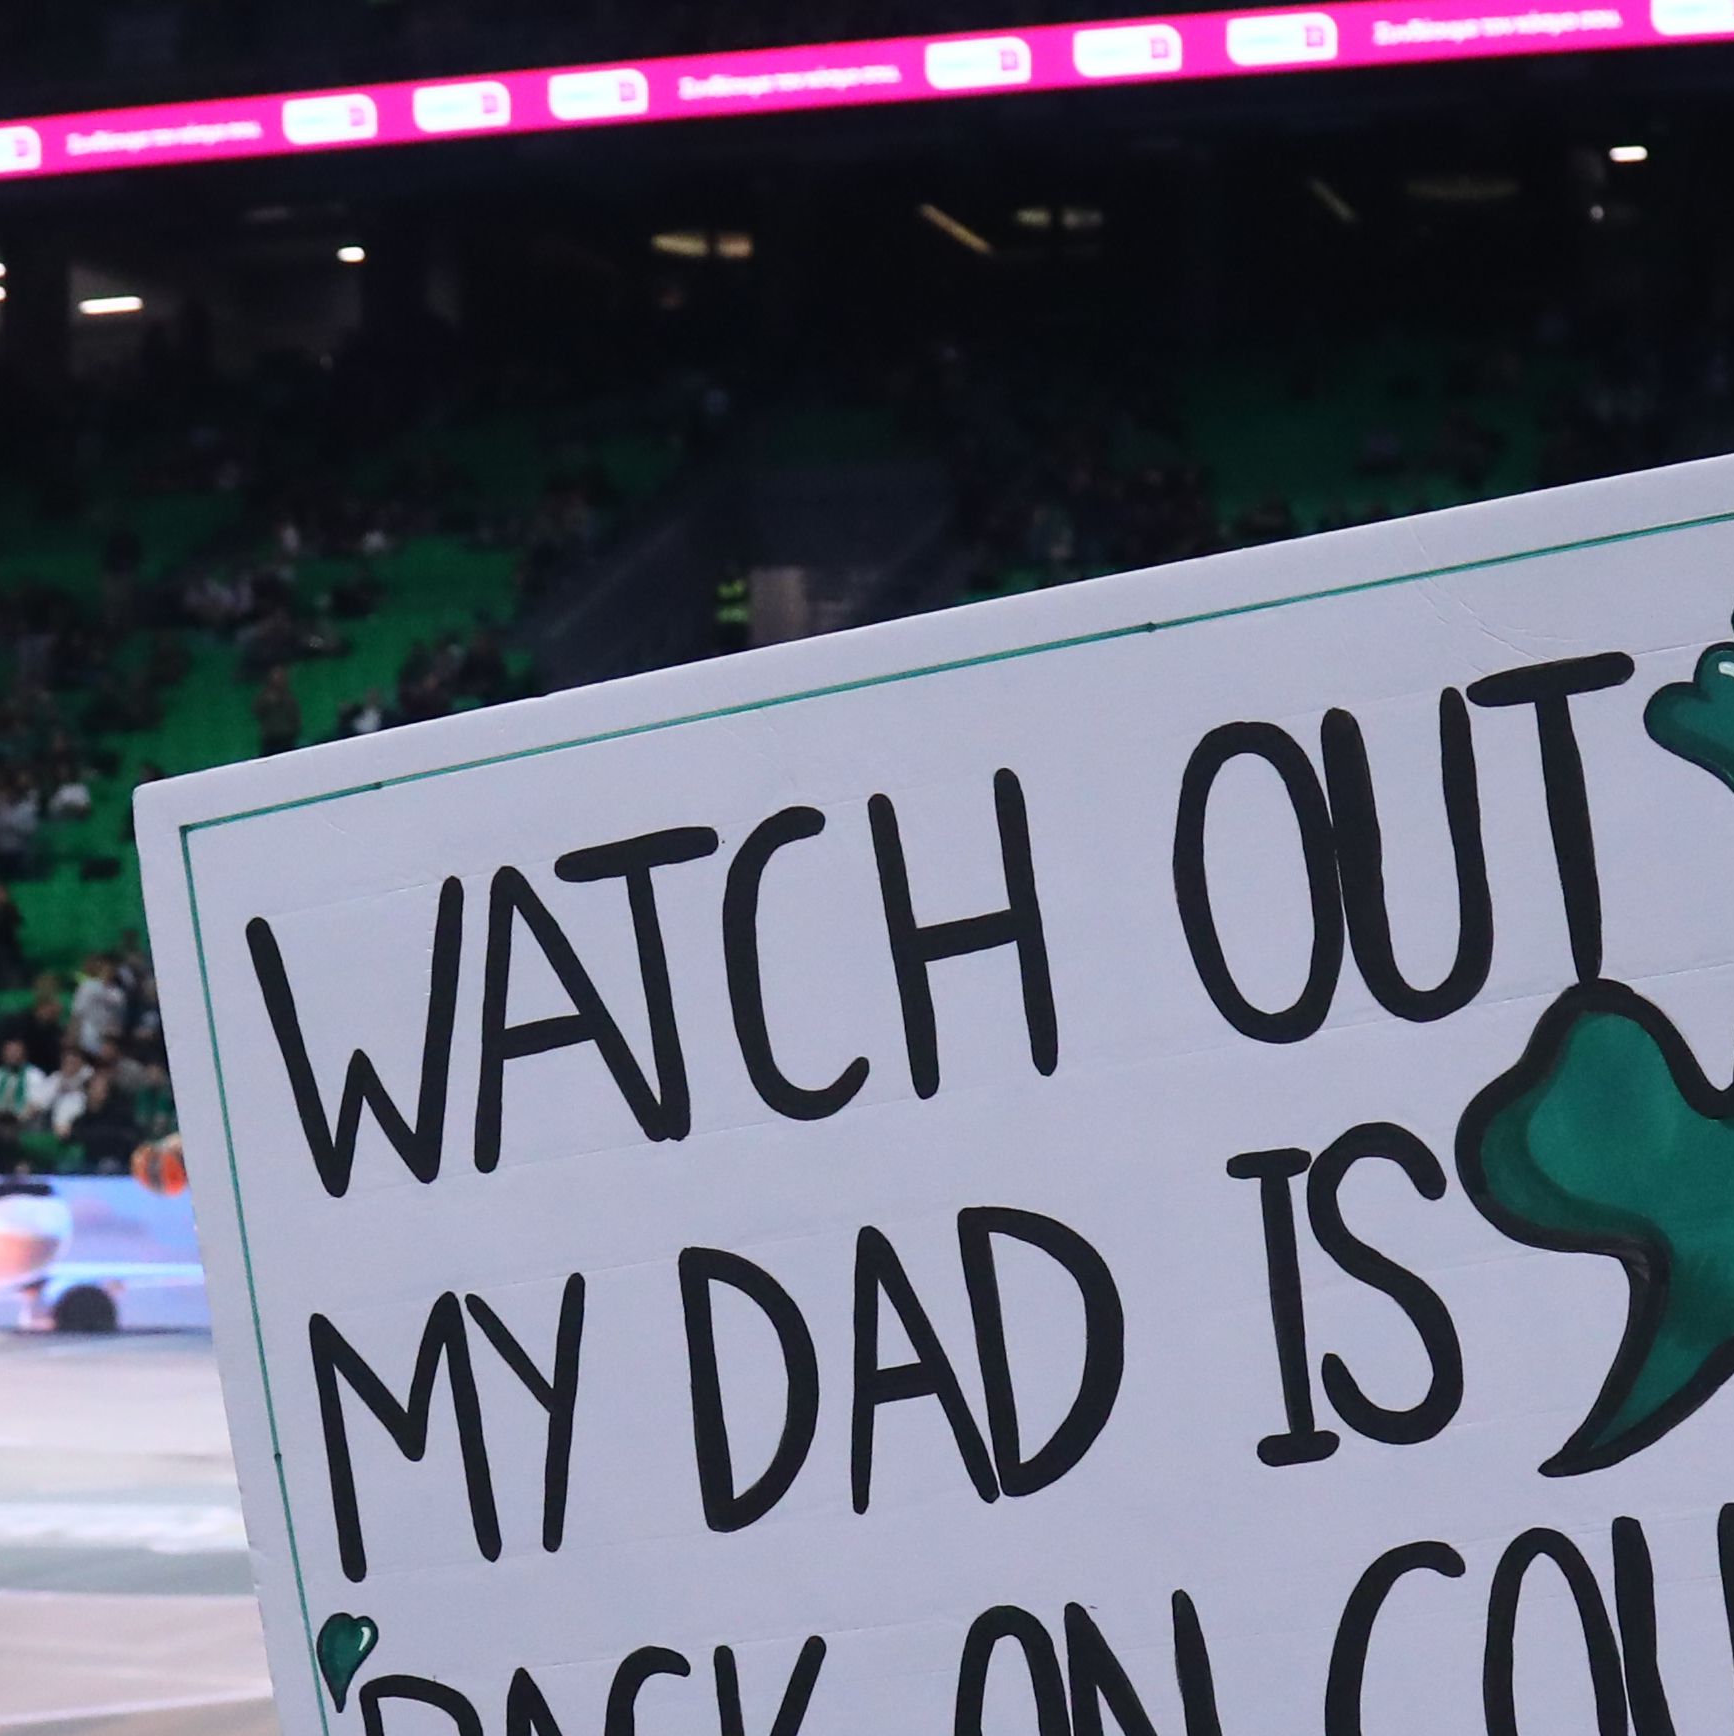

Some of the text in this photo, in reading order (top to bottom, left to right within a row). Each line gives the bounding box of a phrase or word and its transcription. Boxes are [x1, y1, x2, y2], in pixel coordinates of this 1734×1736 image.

[246, 652, 1634, 1199] WATCH OUT
[309, 1122, 1463, 1582] MY DAD IS
